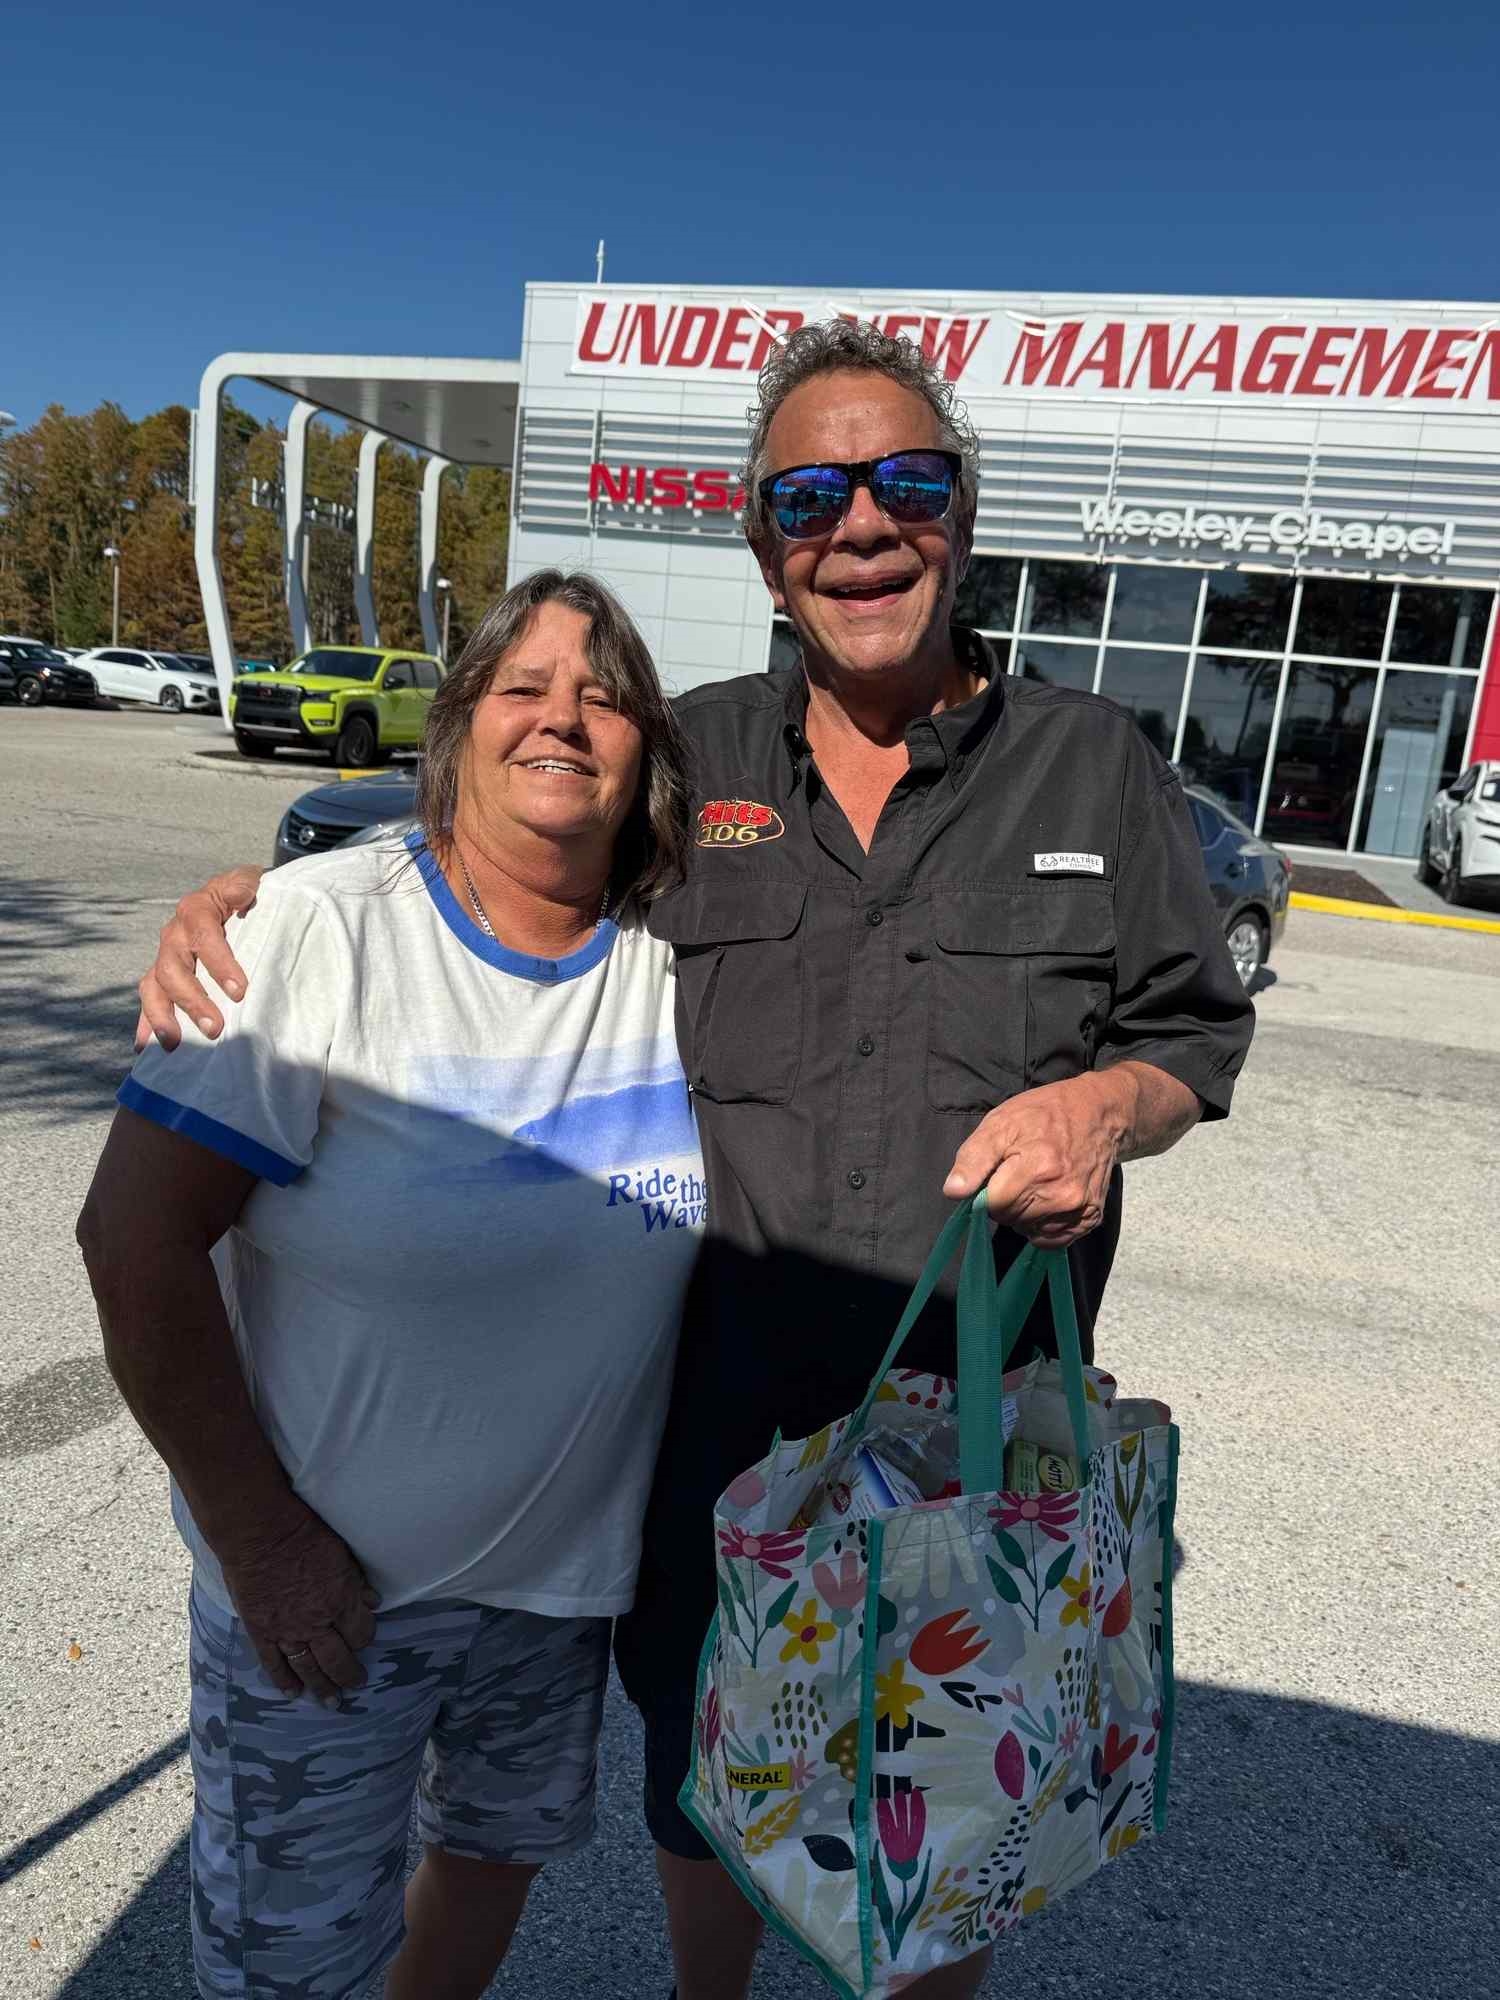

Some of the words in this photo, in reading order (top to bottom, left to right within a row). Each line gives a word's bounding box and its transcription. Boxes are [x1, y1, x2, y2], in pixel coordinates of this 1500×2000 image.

[578, 302, 804, 371] UNDER
[1003, 320, 1500, 401] MANAGEMEN
[1081, 500, 1254, 551] Wesley
[1269, 510, 1456, 559] Chapel
[701, 800, 773, 826] Hits
[700, 824, 759, 842] 106
[1059, 855, 1100, 866] REALTREE
[606, 1168, 677, 1206] Ride
[727, 1770, 784, 1785] NERAL
